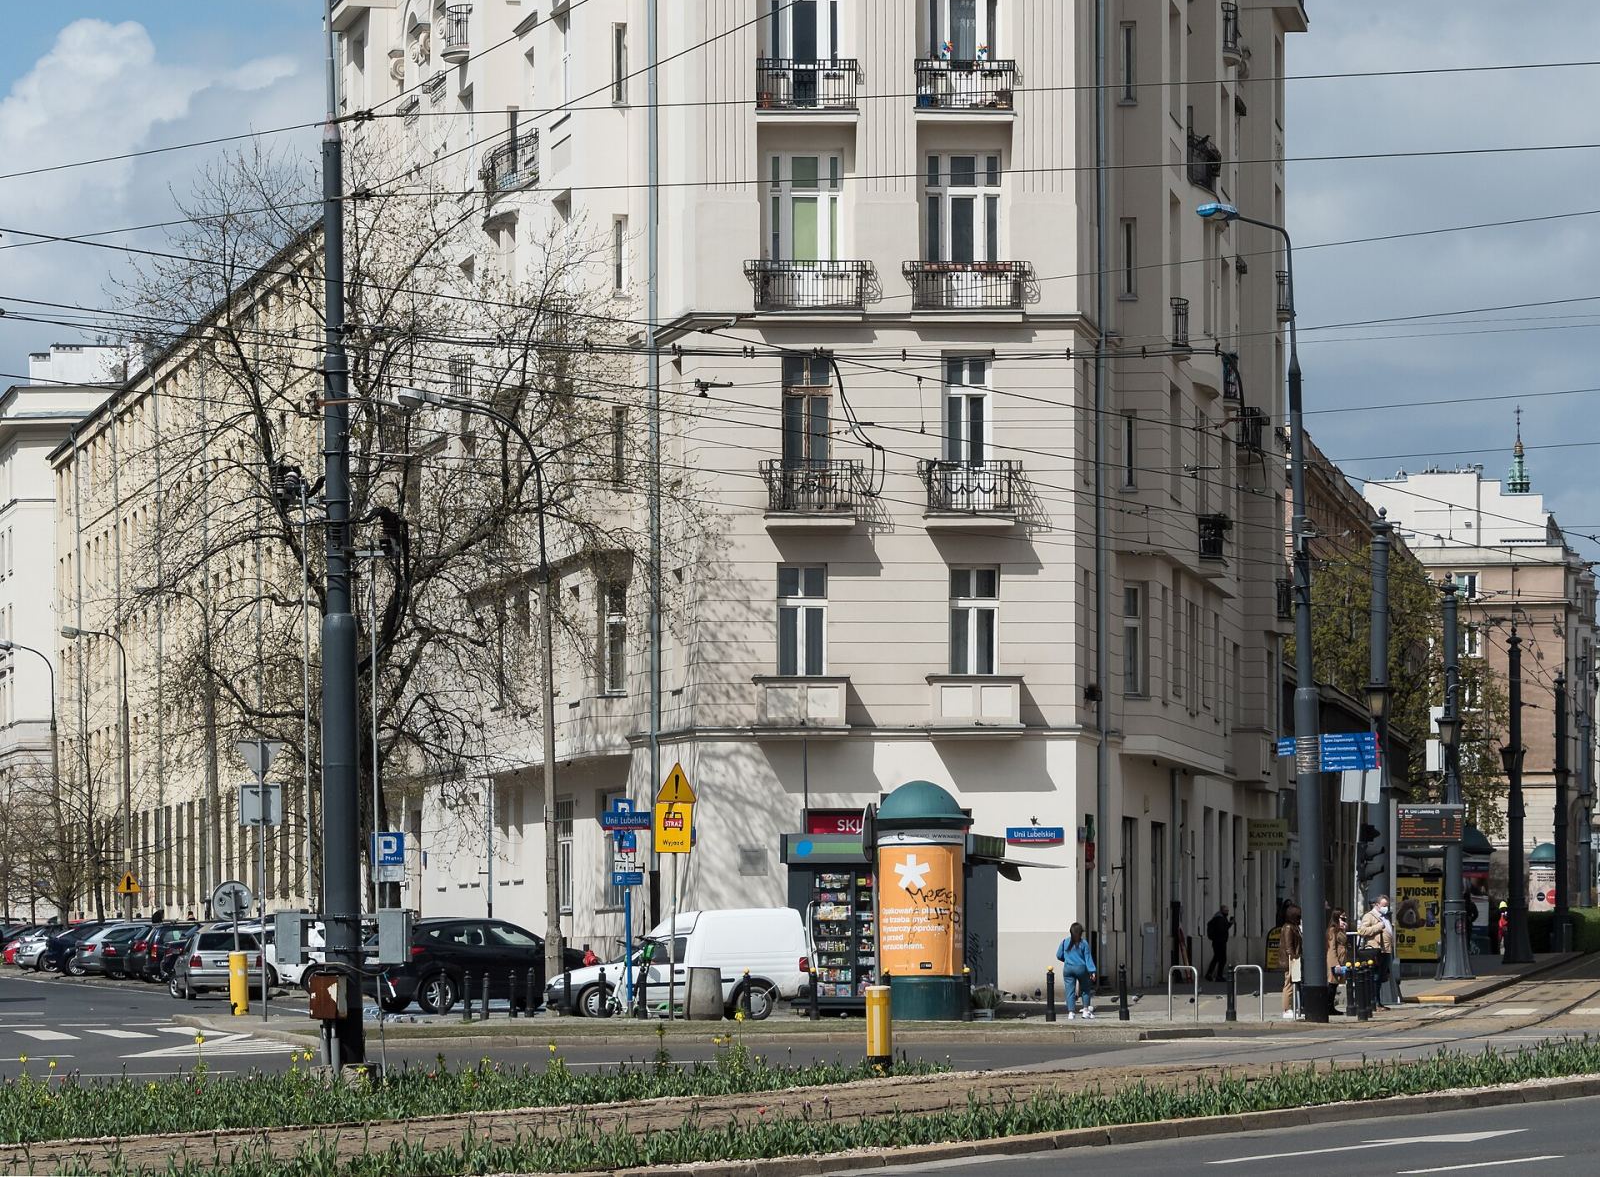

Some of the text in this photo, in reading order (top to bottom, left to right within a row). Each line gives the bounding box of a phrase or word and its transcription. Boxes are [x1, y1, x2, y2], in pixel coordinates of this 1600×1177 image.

[605, 816, 619, 825] Unii
[837, 819, 862, 832] SKL
[1013, 830, 1056, 839] Unii Lubelskiej
[1250, 831, 1284, 839] KANTOR
[663, 839, 684, 847] Wyjazd
[1403, 886, 1440, 898] WIOSNĘ
